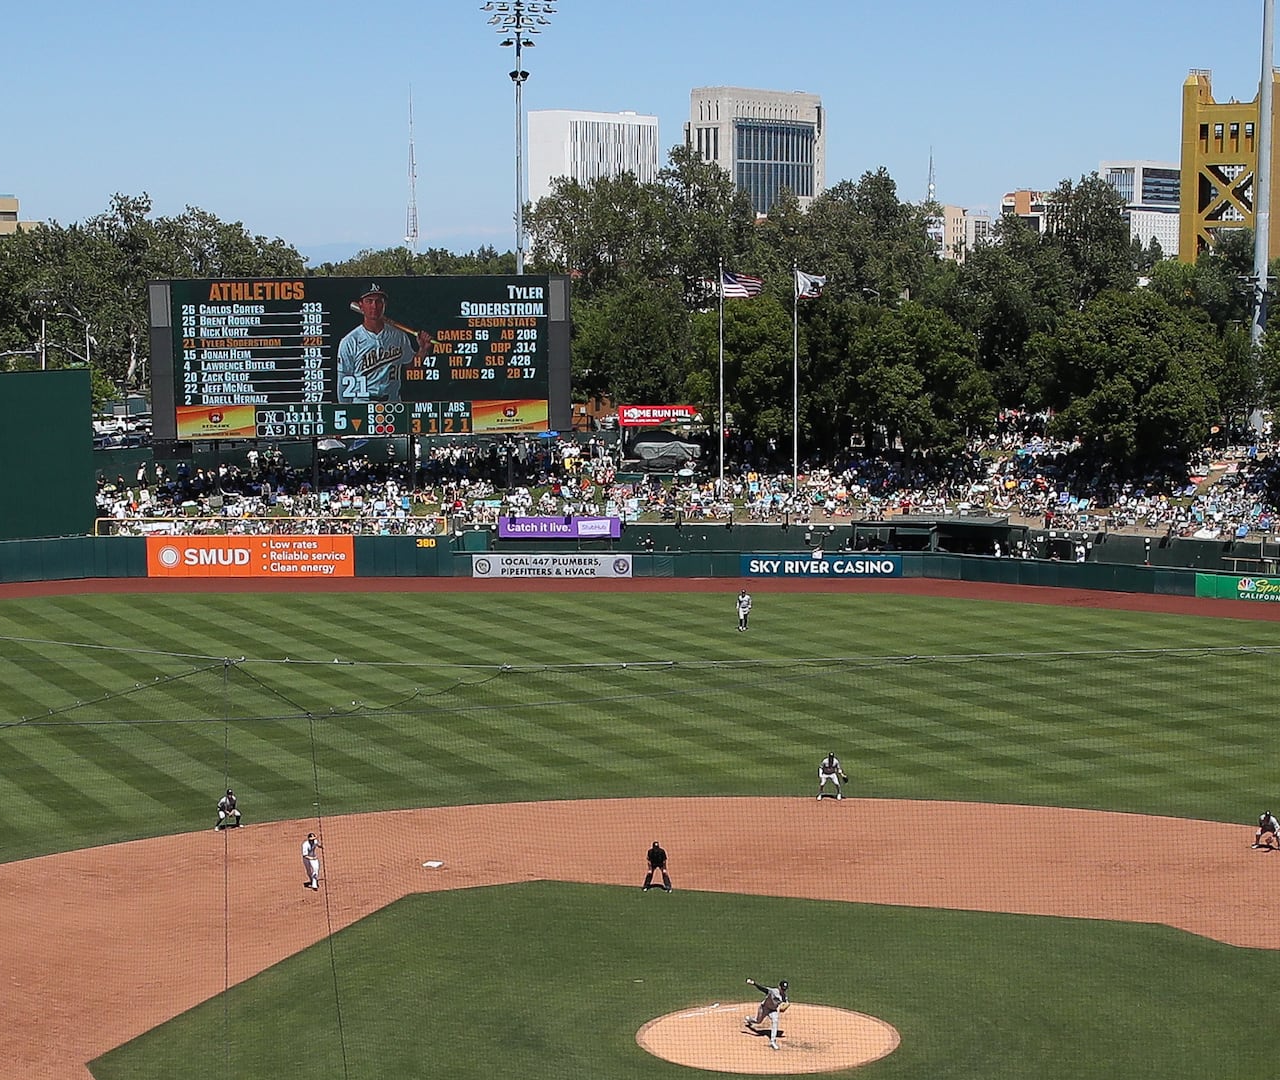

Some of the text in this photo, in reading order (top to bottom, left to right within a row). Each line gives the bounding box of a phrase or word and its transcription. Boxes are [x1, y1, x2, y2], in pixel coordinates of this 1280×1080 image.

[209, 281, 305, 301] ATHLETICS
[507, 285, 543, 299] TYLER
[182, 303, 322, 315] 26 CARLOS CORTES .333
[461, 302, 543, 316] SODERSTROM
[182, 315, 261, 326] 25 BRENT ROOKER
[468, 318, 536, 328] SEASON STATS
[182, 326, 322, 338] 16 NICK KURTZ .285
[437, 330, 537, 340] GAMES 56 AB 208
[183, 339, 195, 348] 21
[433, 343, 536, 354] AVG .226 OBP .314
[183, 350, 251, 360] 15 JONAH HEIM
[183, 359, 322, 371] 4 LAWRENCE BUTLER .167
[414, 355, 530, 367] H 47 HR 7 SLG .428
[184, 372, 250, 382] 20 ZACK GELOF
[406, 368, 535, 380] RBI 26 RUNS 26 2B 17
[184, 384, 222, 393] 22 JEFF
[342, 375, 369, 398] 21
[184, 393, 323, 405] 2 DARELL HERNAIZ .257
[415, 402, 432, 413] MVR
[448, 402, 465, 412] ABS
[286, 411, 311, 422] 13 11
[653, 409, 671, 417] RUN
[672, 409, 690, 417] HILL
[334, 410, 347, 430] 5
[411, 418, 437, 433] 3 1
[444, 418, 469, 432] 2 1
[289, 424, 310, 434] 3 5
[507, 522, 572, 532] Catch it live.
[270, 540, 317, 549] Low rates
[416, 538, 436, 548] 380
[184, 549, 250, 566] SMUD
[270, 552, 346, 560] Reliable service
[501, 558, 601, 567] LOCAL 447 PLUMBERS,
[749, 560, 894, 573] SKY RIVER CASINO
[270, 563, 335, 574] Clean energy
[501, 567, 596, 576] PIPEFITTERS HVACR
